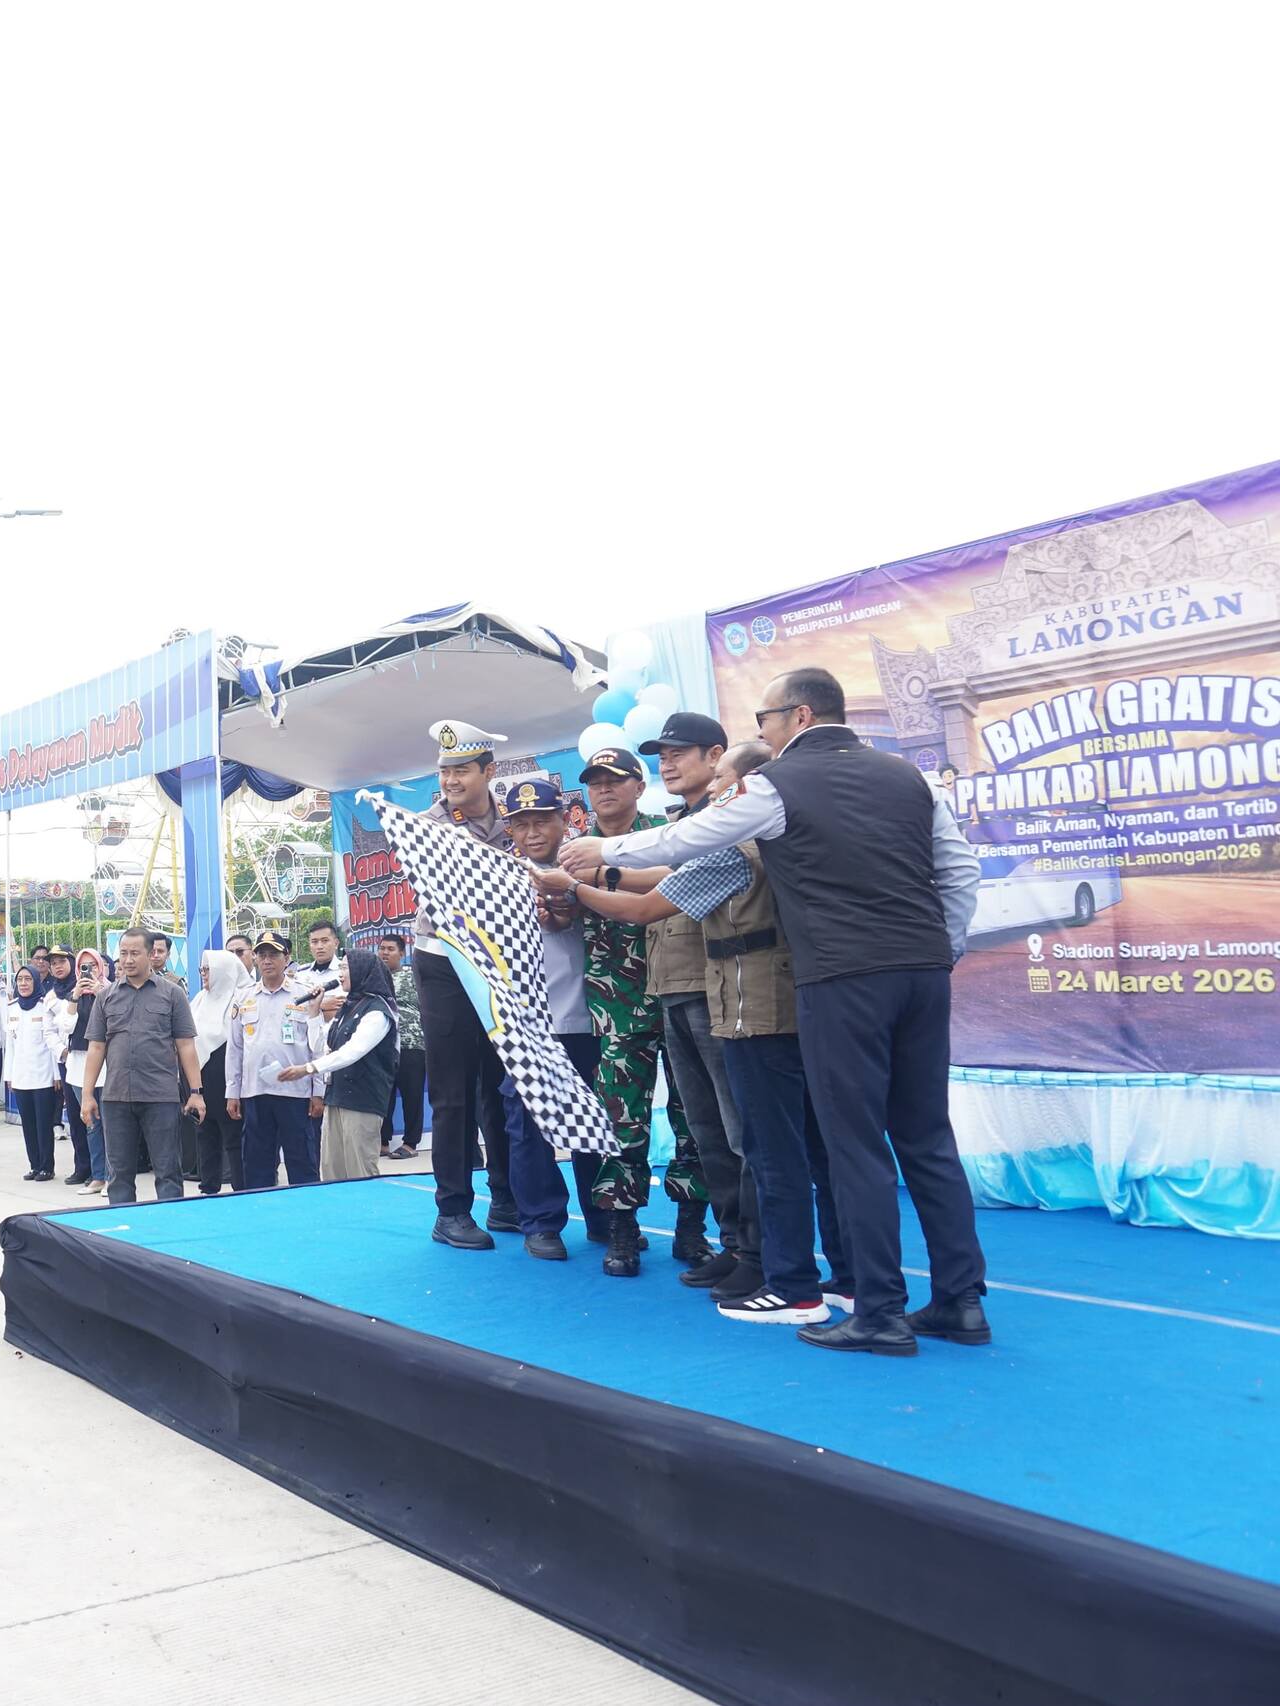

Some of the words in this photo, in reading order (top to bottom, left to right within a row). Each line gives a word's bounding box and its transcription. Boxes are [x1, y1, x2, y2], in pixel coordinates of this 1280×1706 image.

[781, 600, 844, 624] PEMERINTAH
[785, 614, 843, 637] KABUPATEN
[844, 600, 902, 624] LAMONGAN
[1044, 584, 1192, 626] KABUPATEN
[1007, 591, 1243, 659] LAMONGAN
[89, 699, 144, 764] Mudik
[982, 687, 1100, 764] BALIK
[1106, 676, 1280, 727] GRATIS
[1083, 729, 1170, 757] BERSAMA
[956, 764, 1096, 815] PEMKAB
[1015, 819, 1053, 836] Balik
[1054, 817, 1101, 833] Aman,
[1104, 810, 1180, 830] Nyaman,
[1183, 805, 1219, 821] dan
[1222, 798, 1278, 817] Tertib
[978, 843, 1039, 858] Bersama
[1042, 834, 1129, 854] Pemerintah
[1132, 826, 1229, 847] Kabupaten
[1033, 842, 1262, 872] #BalikGratisLamongan2026
[349, 878, 419, 931] Mudik
[1052, 942, 1115, 959] Stadion
[1119, 941, 1200, 961] Surajaya
[1056, 970, 1089, 992] 24
[1094, 969, 1184, 993] Maret
[1192, 967, 1276, 993] 2026
